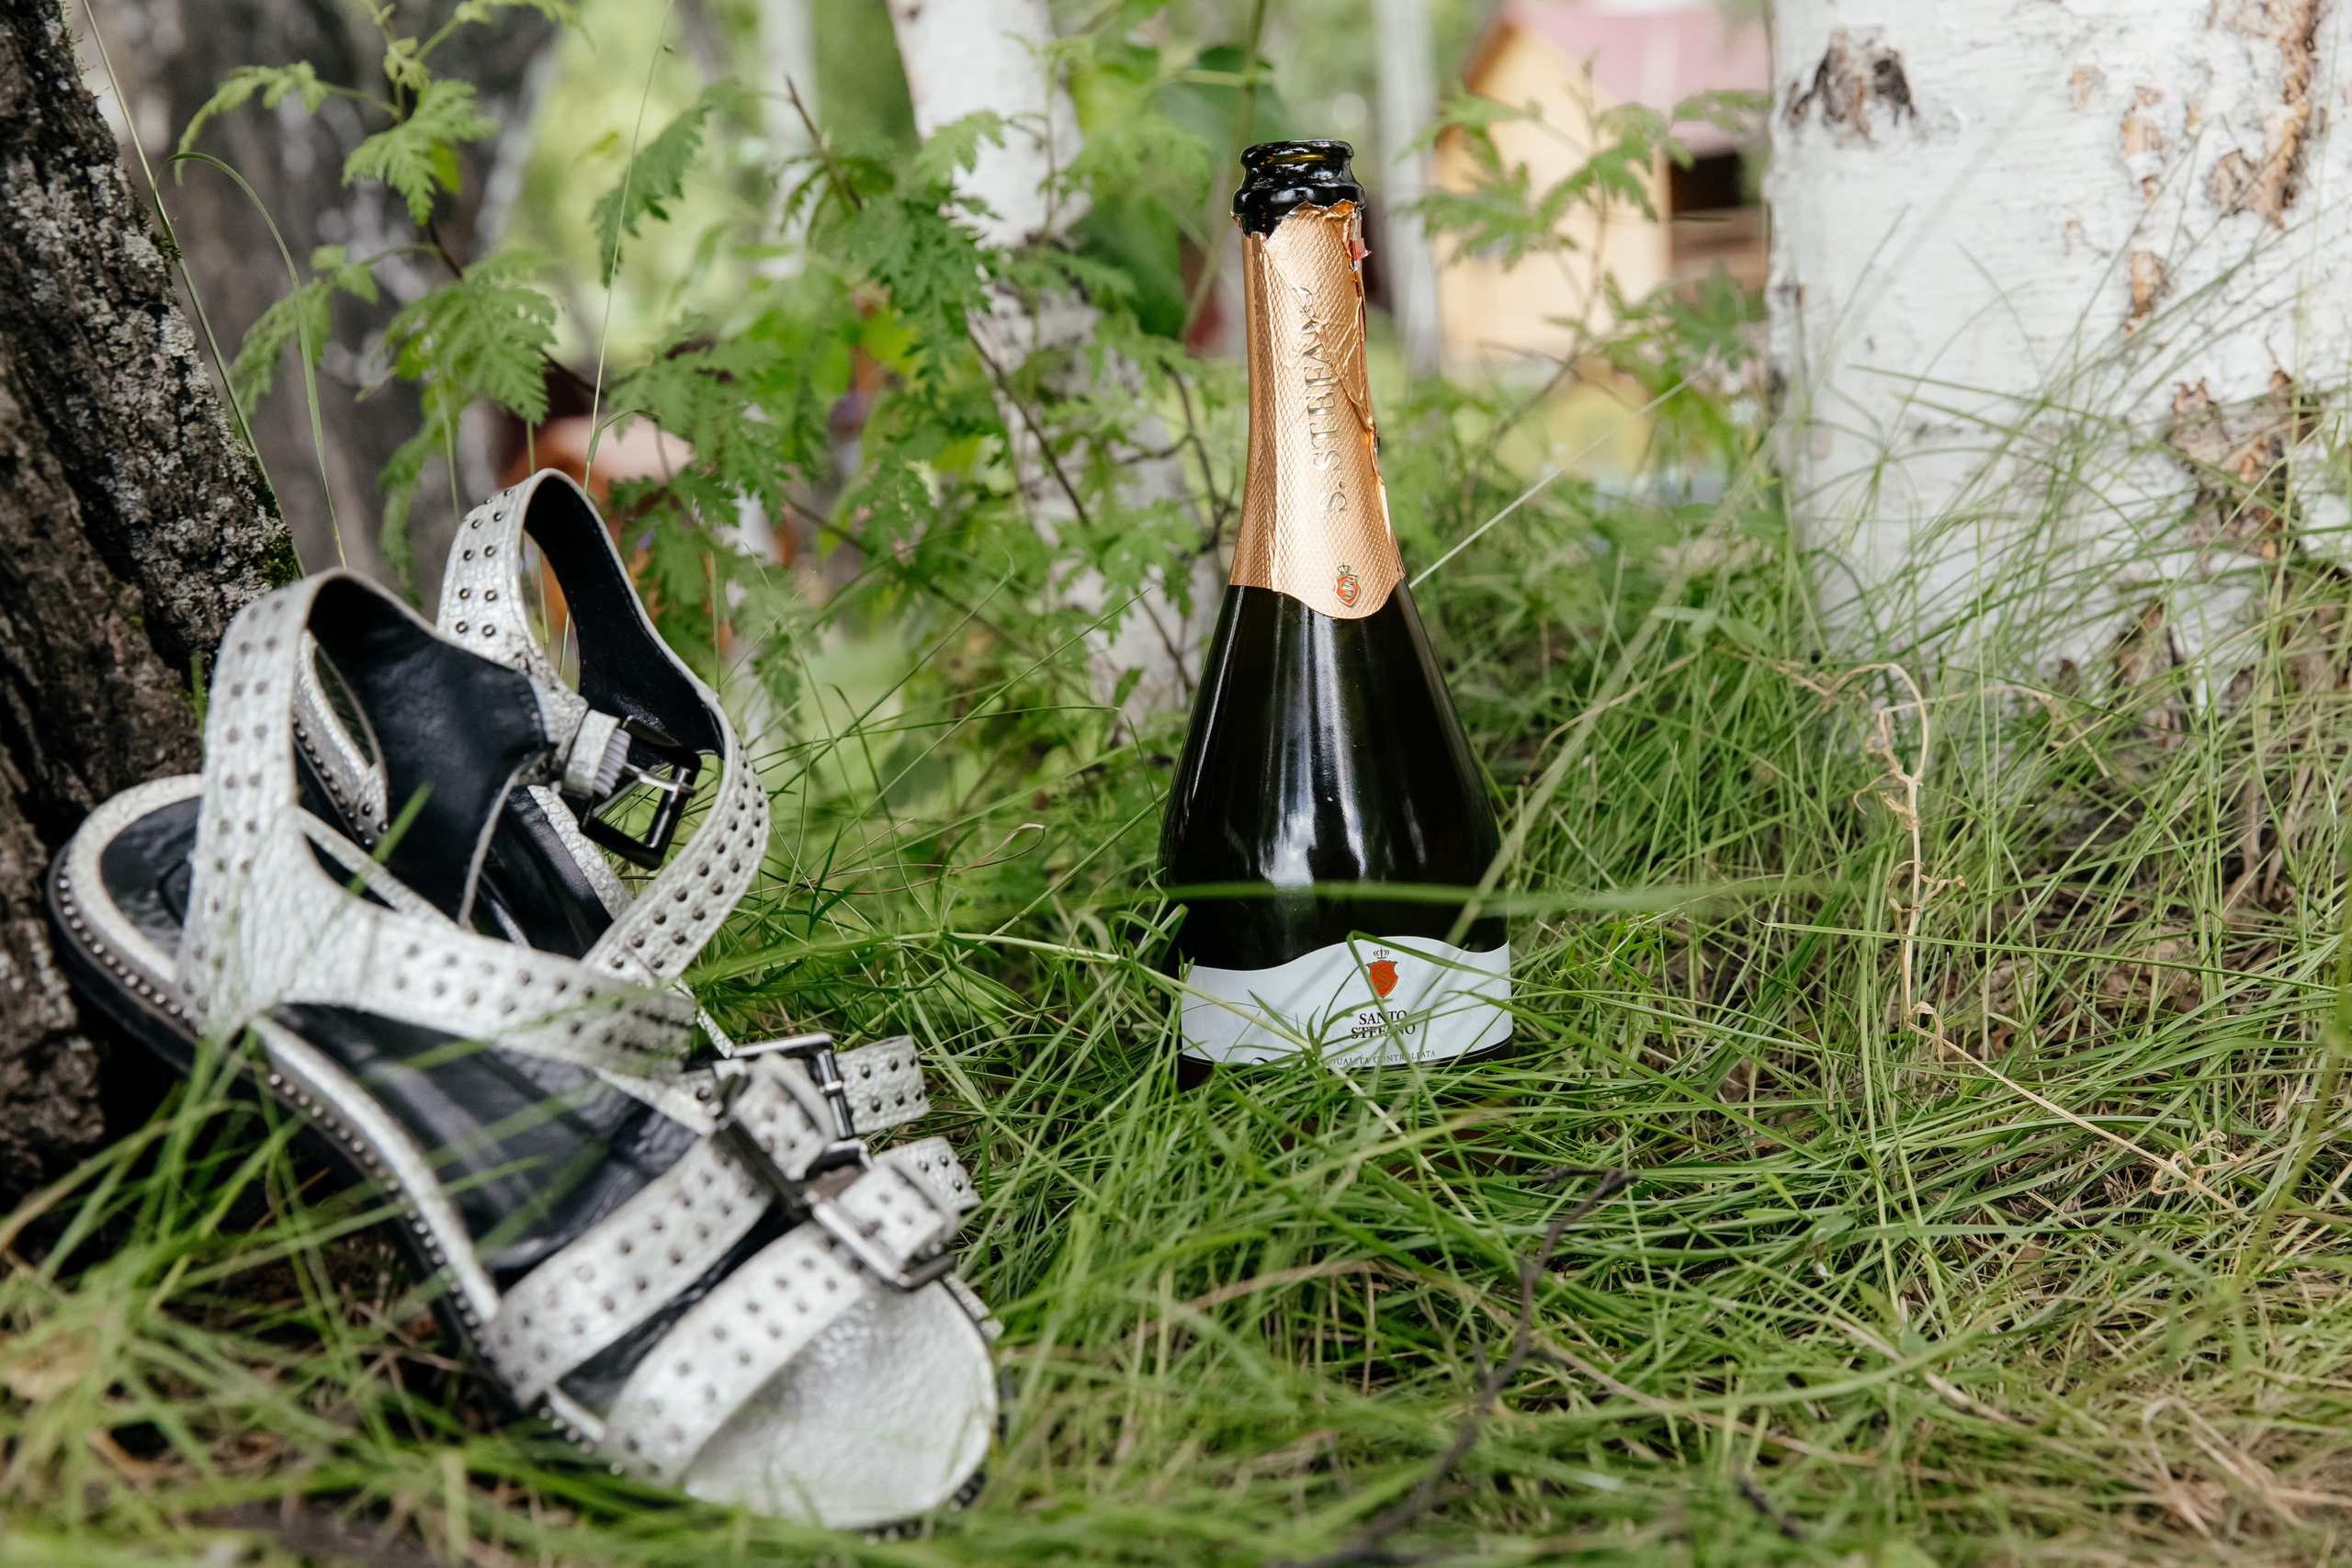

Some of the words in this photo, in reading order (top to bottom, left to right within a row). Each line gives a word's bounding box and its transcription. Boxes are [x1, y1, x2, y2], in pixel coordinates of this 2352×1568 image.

[1358, 1010, 1408, 1025] SANTO
[1351, 1023, 1416, 1039] STEFNO
[1329, 1055, 1370, 1066] QUALTA
[1373, 1050, 1436, 1064] CONTRLLATA
